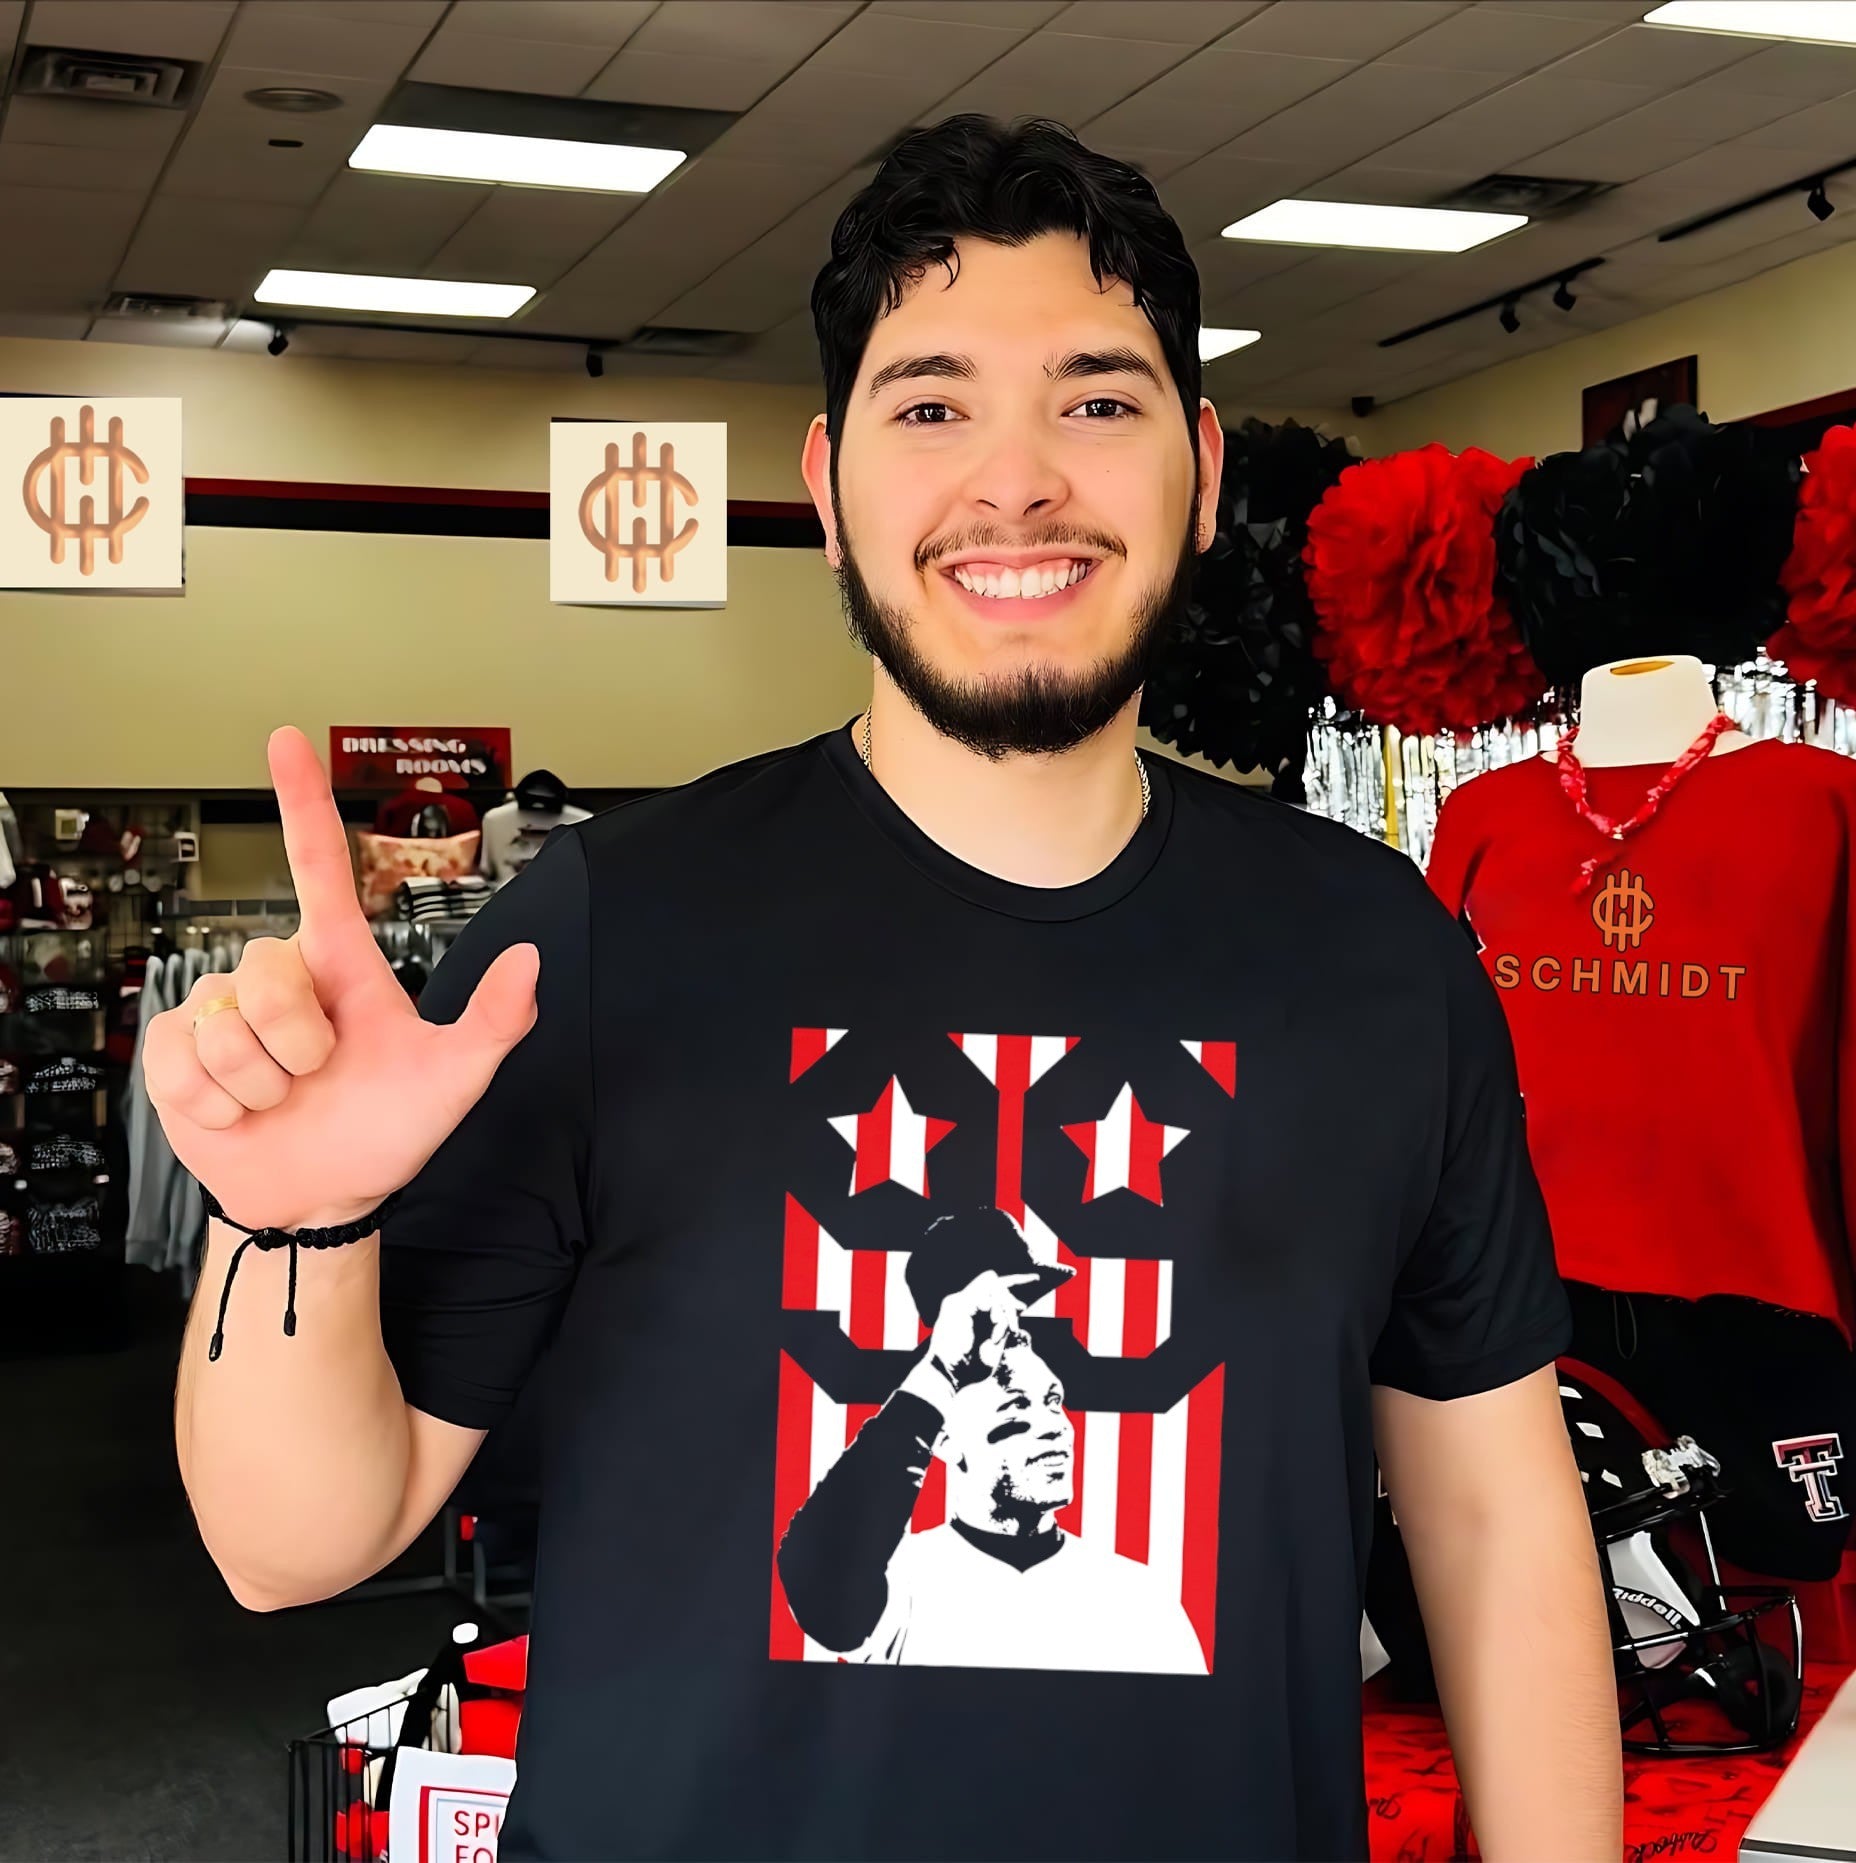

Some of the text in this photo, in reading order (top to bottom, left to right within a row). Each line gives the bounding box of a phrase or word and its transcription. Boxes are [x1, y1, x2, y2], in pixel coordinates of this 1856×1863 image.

[342, 737, 466, 753] DRESSING
[396, 758, 486, 774] ROOMS
[1494, 954, 1747, 1001] SCHMIDT
